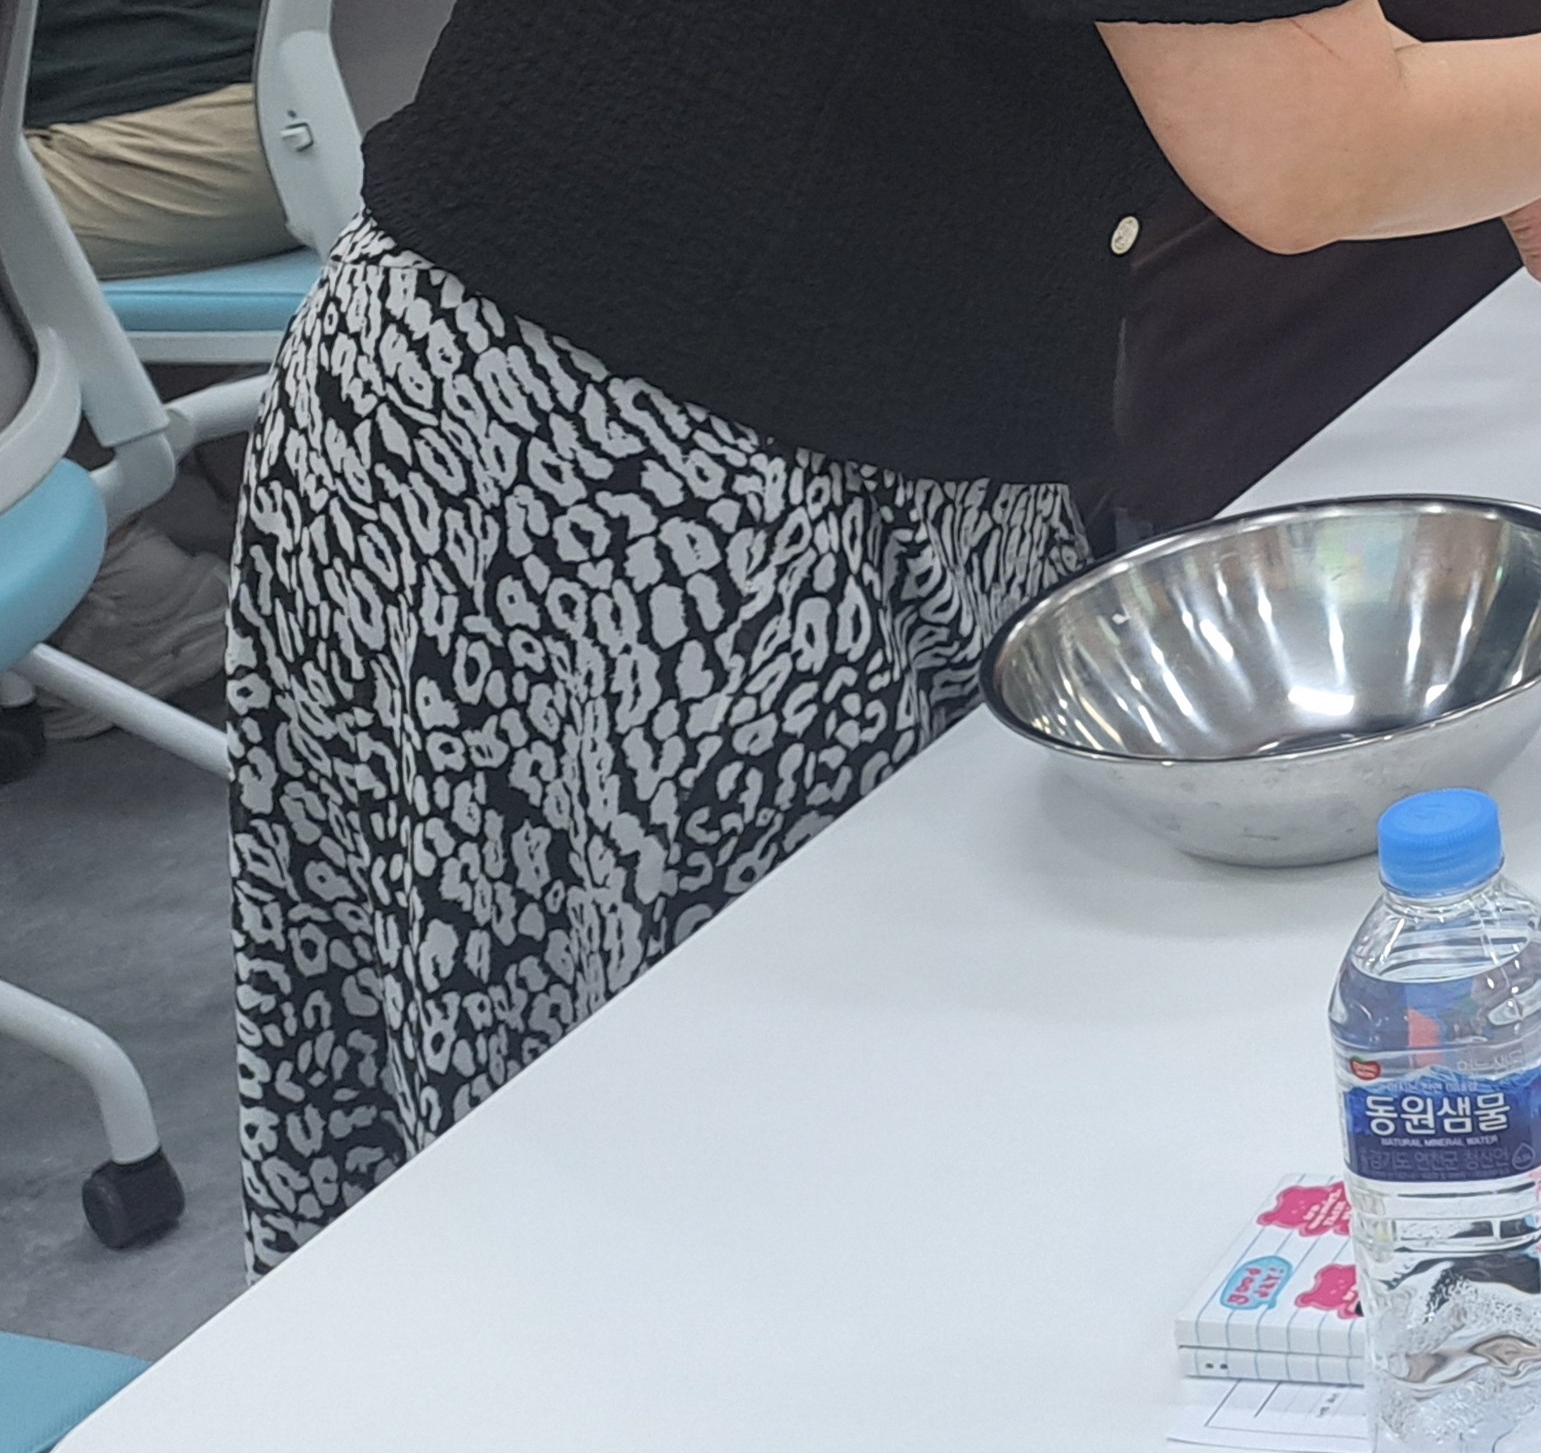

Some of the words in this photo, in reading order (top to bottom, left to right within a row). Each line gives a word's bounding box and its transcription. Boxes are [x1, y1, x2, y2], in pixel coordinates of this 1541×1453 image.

[1365, 1092, 1509, 1135] 동원샘물
[1381, 1138, 1420, 1147] NATURAL
[1423, 1138, 1464, 1146] MINERAL
[1466, 1135, 1498, 1145] WATER
